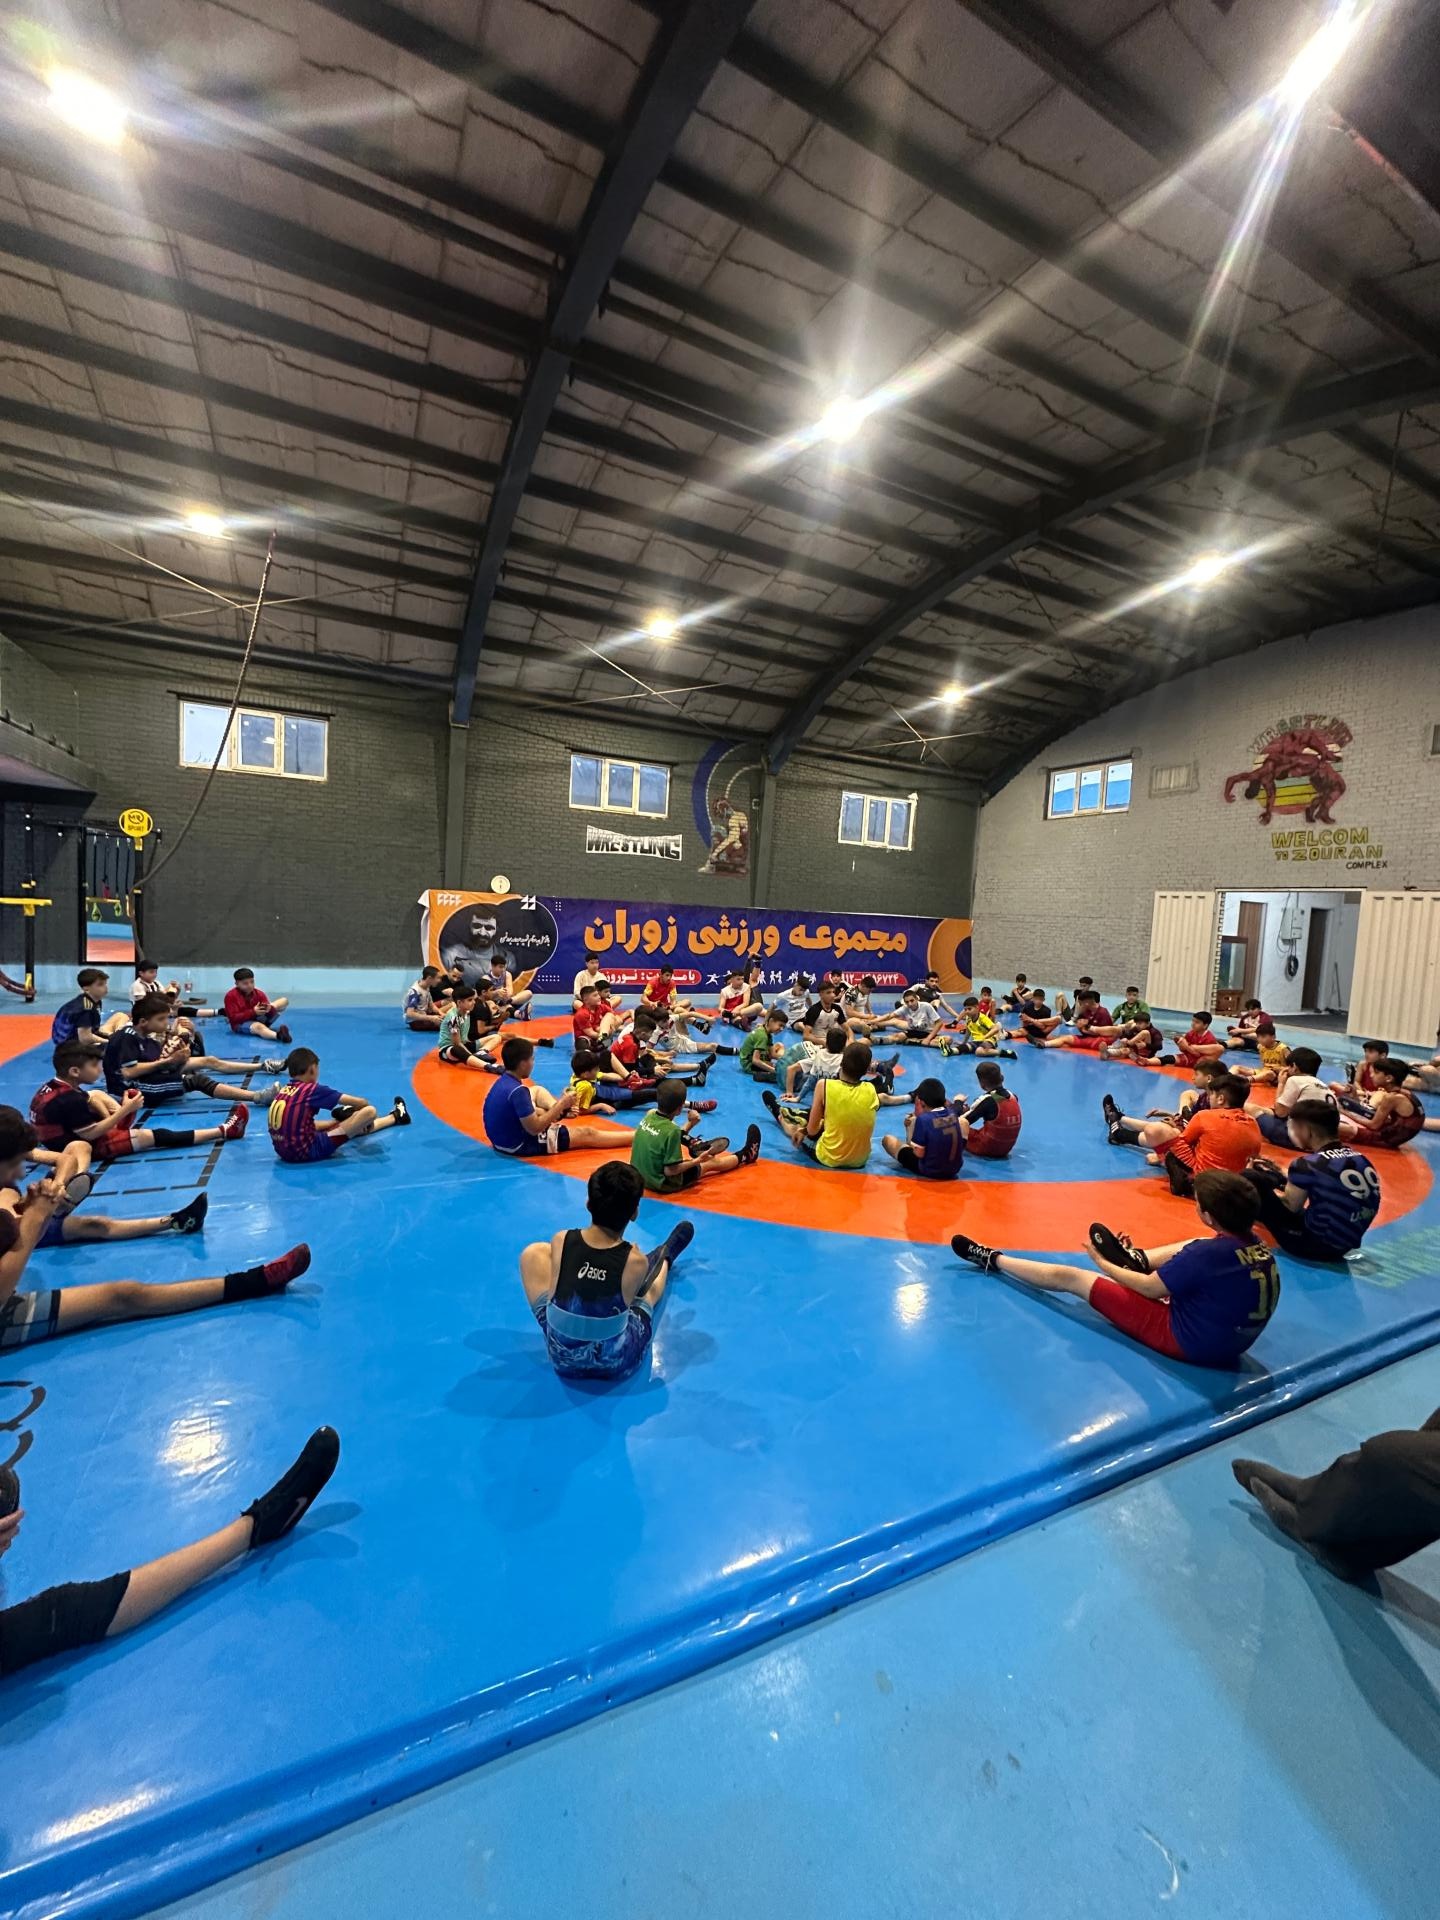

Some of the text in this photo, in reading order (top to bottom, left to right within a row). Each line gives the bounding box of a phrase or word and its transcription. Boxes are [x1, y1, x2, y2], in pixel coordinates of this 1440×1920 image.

[586, 824, 682, 861] WRESTLING
[1271, 827, 1369, 849] WELCOM
[1292, 845, 1383, 861] ZOURAN
[1345, 860, 1388, 870] COMPLEX
[584, 909, 908, 959] مجموعه ورزشی زوران
[1340, 1165, 1380, 1200] 99
